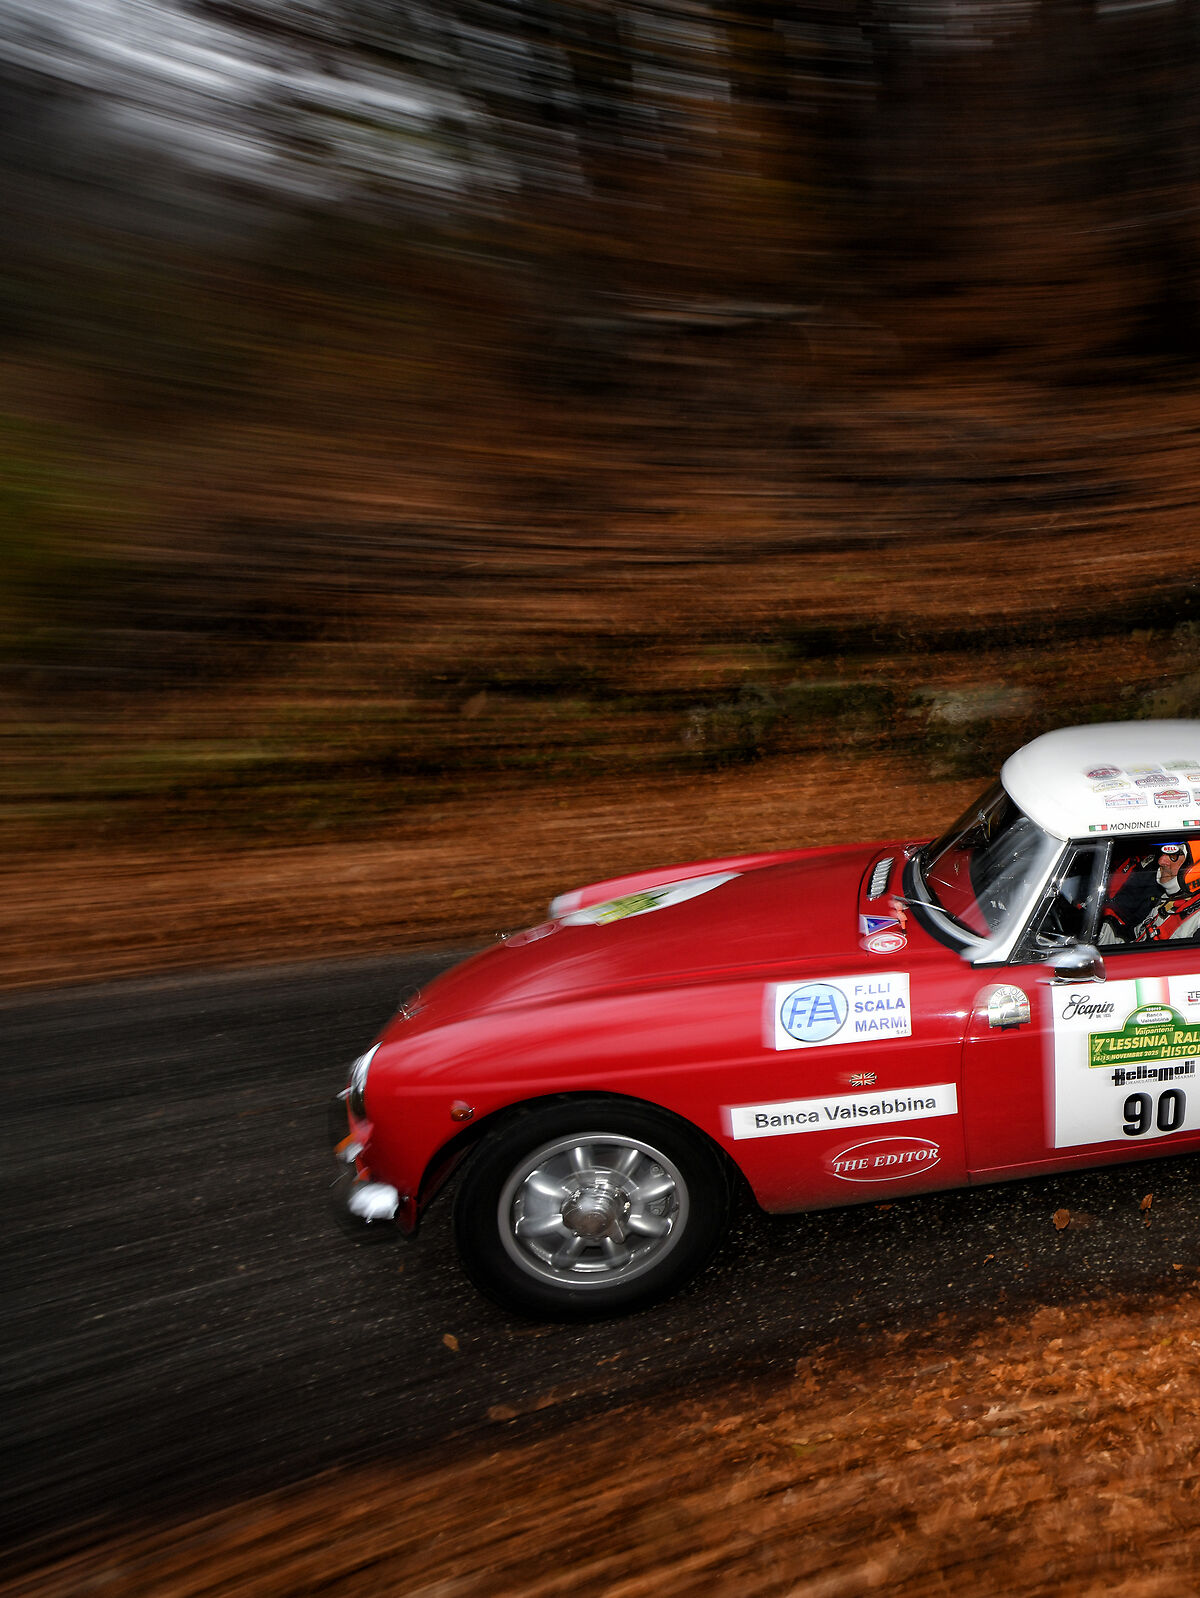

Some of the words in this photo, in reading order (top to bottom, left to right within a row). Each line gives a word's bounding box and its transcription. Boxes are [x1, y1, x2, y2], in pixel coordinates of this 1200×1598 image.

[1109, 820, 1161, 831] MONDINELLI
[854, 982, 891, 996] F.LLI
[854, 997, 906, 1013] SCALA
[1062, 994, 1115, 1020] Scapin
[855, 1016, 907, 1033] MARMI
[1109, 1034, 1168, 1051] LESSINIA
[1111, 1052, 1143, 1060] NOVEMBRE
[1112, 1060, 1195, 1086] Bellamoli
[755, 1112, 820, 1129] Banca
[824, 1096, 937, 1121] Valsabbina
[1122, 1088, 1187, 1136] 90
[833, 1158, 869, 1173] THE
[874, 1148, 939, 1168] EDITOR
